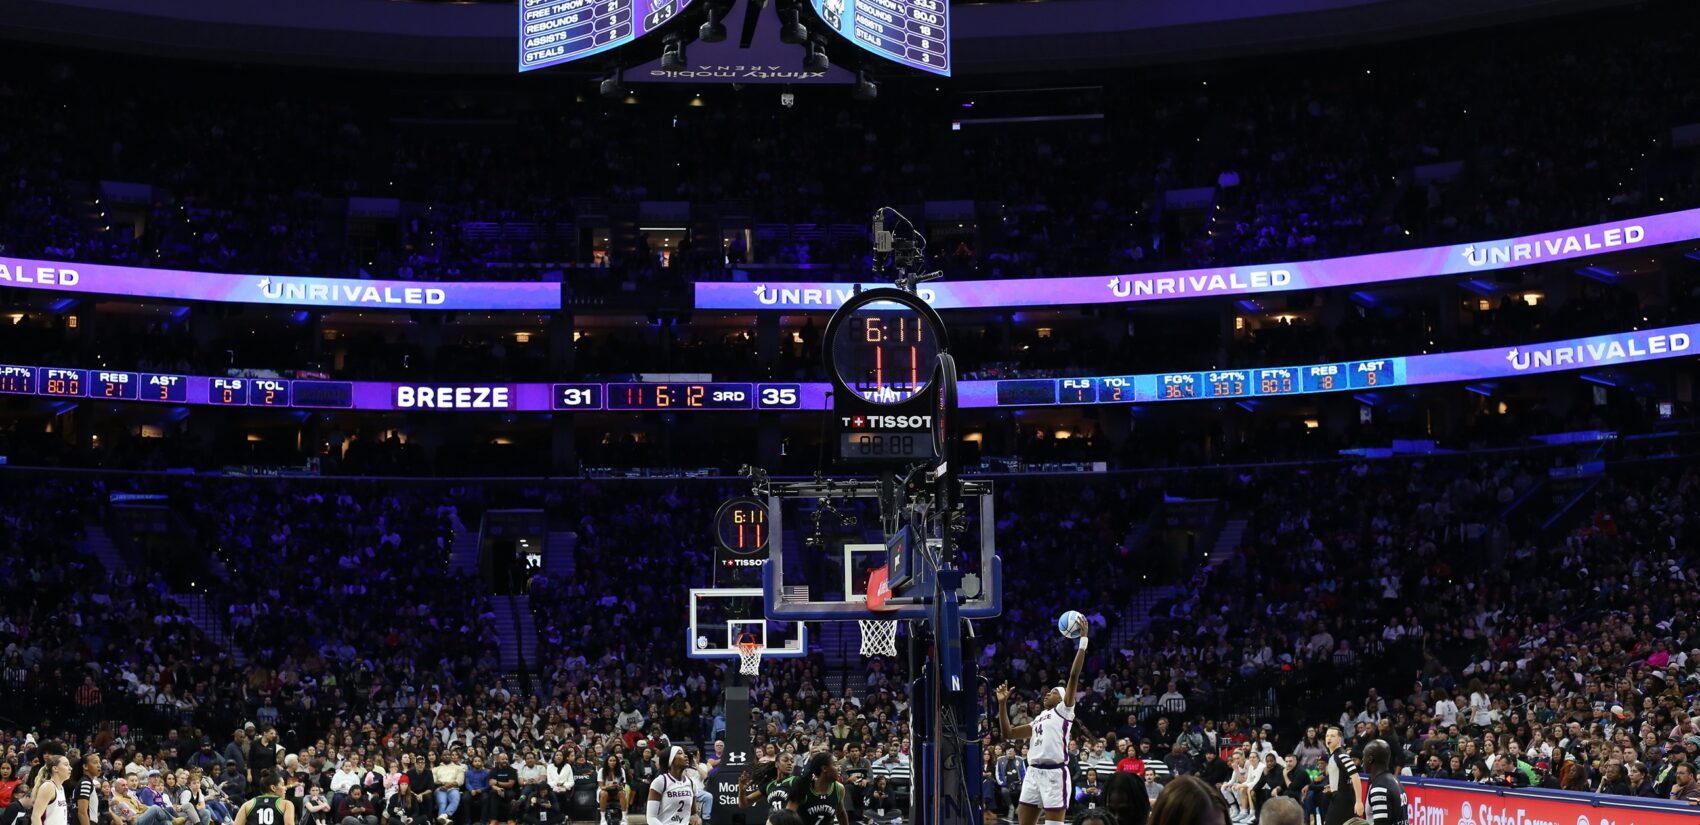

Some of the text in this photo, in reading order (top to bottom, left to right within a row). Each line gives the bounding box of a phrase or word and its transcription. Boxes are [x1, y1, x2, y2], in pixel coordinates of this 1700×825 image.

[526, 7, 551, 20] FREE
[552, 0, 583, 13] THROW
[608, 1, 618, 11] 21
[874, 0, 896, 10] HROW
[526, 14, 579, 33] REBOUNDS
[609, 16, 617, 25] 3
[856, 14, 884, 33] ASSISTS
[913, 10, 937, 24] 80.0
[609, 30, 617, 39] 2
[856, 28, 882, 46] STEALS
[920, 25, 931, 36] 18
[526, 31, 567, 47] ASSISTS
[921, 40, 930, 49] 8
[526, 46, 565, 62] STEALS
[921, 53, 930, 63] 3
[650, 70, 827, 80] xfinity mobile
[1464, 225, 1646, 267] UNRIVALED
[1110, 269, 1292, 298] UNRIVALED
[259, 279, 446, 304] UNRIVALED
[866, 317, 922, 342] 6:11
[1509, 333, 1691, 370] UNRIVALED
[0, 366, 30, 377] -PT%
[876, 346, 917, 391] 11
[1311, 366, 1338, 377] REB
[1357, 361, 1385, 372] AST
[49, 370, 78, 380] FT%
[100, 372, 129, 383] REB
[150, 375, 178, 386] AST
[1164, 374, 1194, 384] FG%
[1209, 372, 1245, 382] 3-PT%
[1261, 369, 1290, 379] FT%
[1367, 371, 1377, 385] 8
[47, 380, 78, 394] 80.0
[105, 382, 122, 397] 21
[214, 379, 242, 390] FLS
[256, 381, 284, 391] TOL
[1063, 378, 1090, 389] FLS
[1103, 378, 1131, 387] TOL
[1213, 382, 1243, 396] 33.3
[1261, 379, 1291, 393] 80.0
[160, 385, 168, 399] 3
[223, 389, 232, 403] 0
[265, 390, 274, 404] 2
[397, 386, 509, 408] BREEZE
[563, 388, 591, 405] 31
[627, 386, 745, 407] 11 6:12 3RD
[762, 388, 797, 405] 35
[1113, 387, 1121, 400] 2
[866, 415, 932, 428] TISSOT
[734, 509, 763, 523] 6:11
[739, 524, 760, 548] 11
[677, 800, 685, 812] 2
[256, 807, 274, 825] 10
